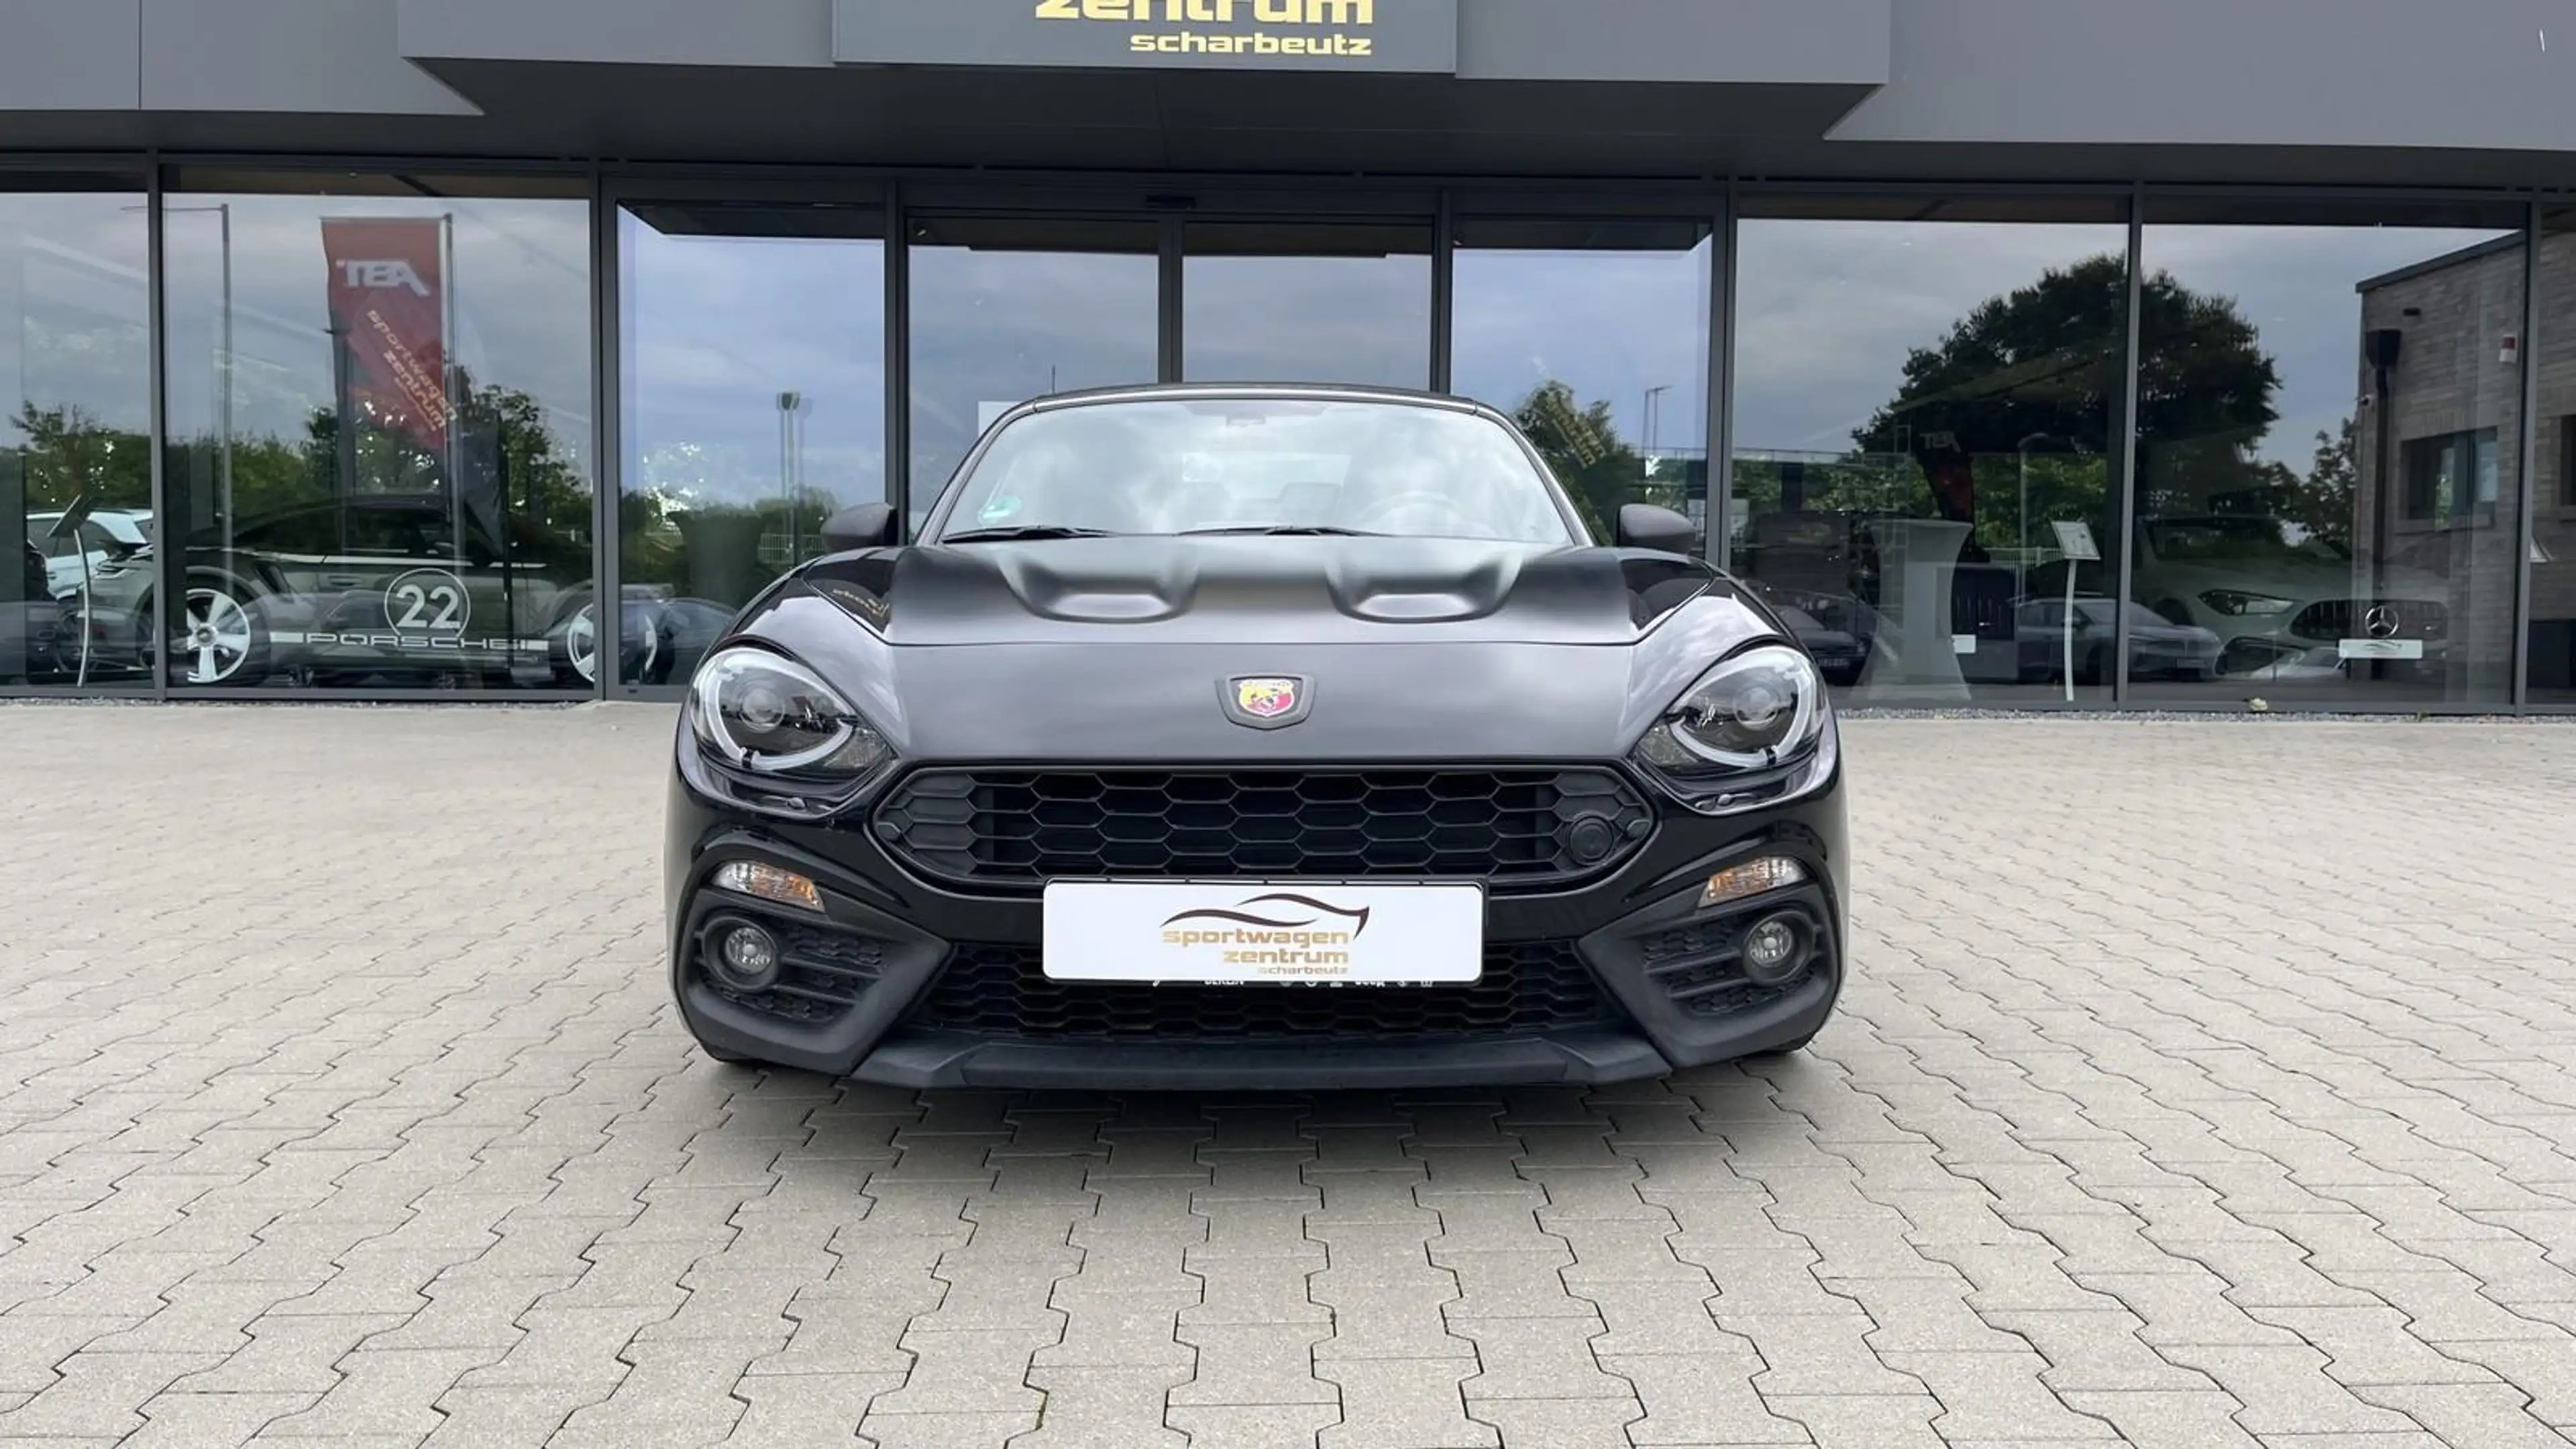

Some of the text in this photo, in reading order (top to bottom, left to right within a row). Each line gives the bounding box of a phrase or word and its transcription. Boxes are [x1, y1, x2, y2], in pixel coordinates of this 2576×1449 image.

[1130, 31, 1373, 56] scharbeutz
[396, 584, 462, 629] 22
[306, 632, 518, 651] PORSCHE
[1162, 928, 1349, 948] sportwagen
[1223, 948, 1349, 964] zentrum
[1258, 965, 1348, 975] scharbeutz
